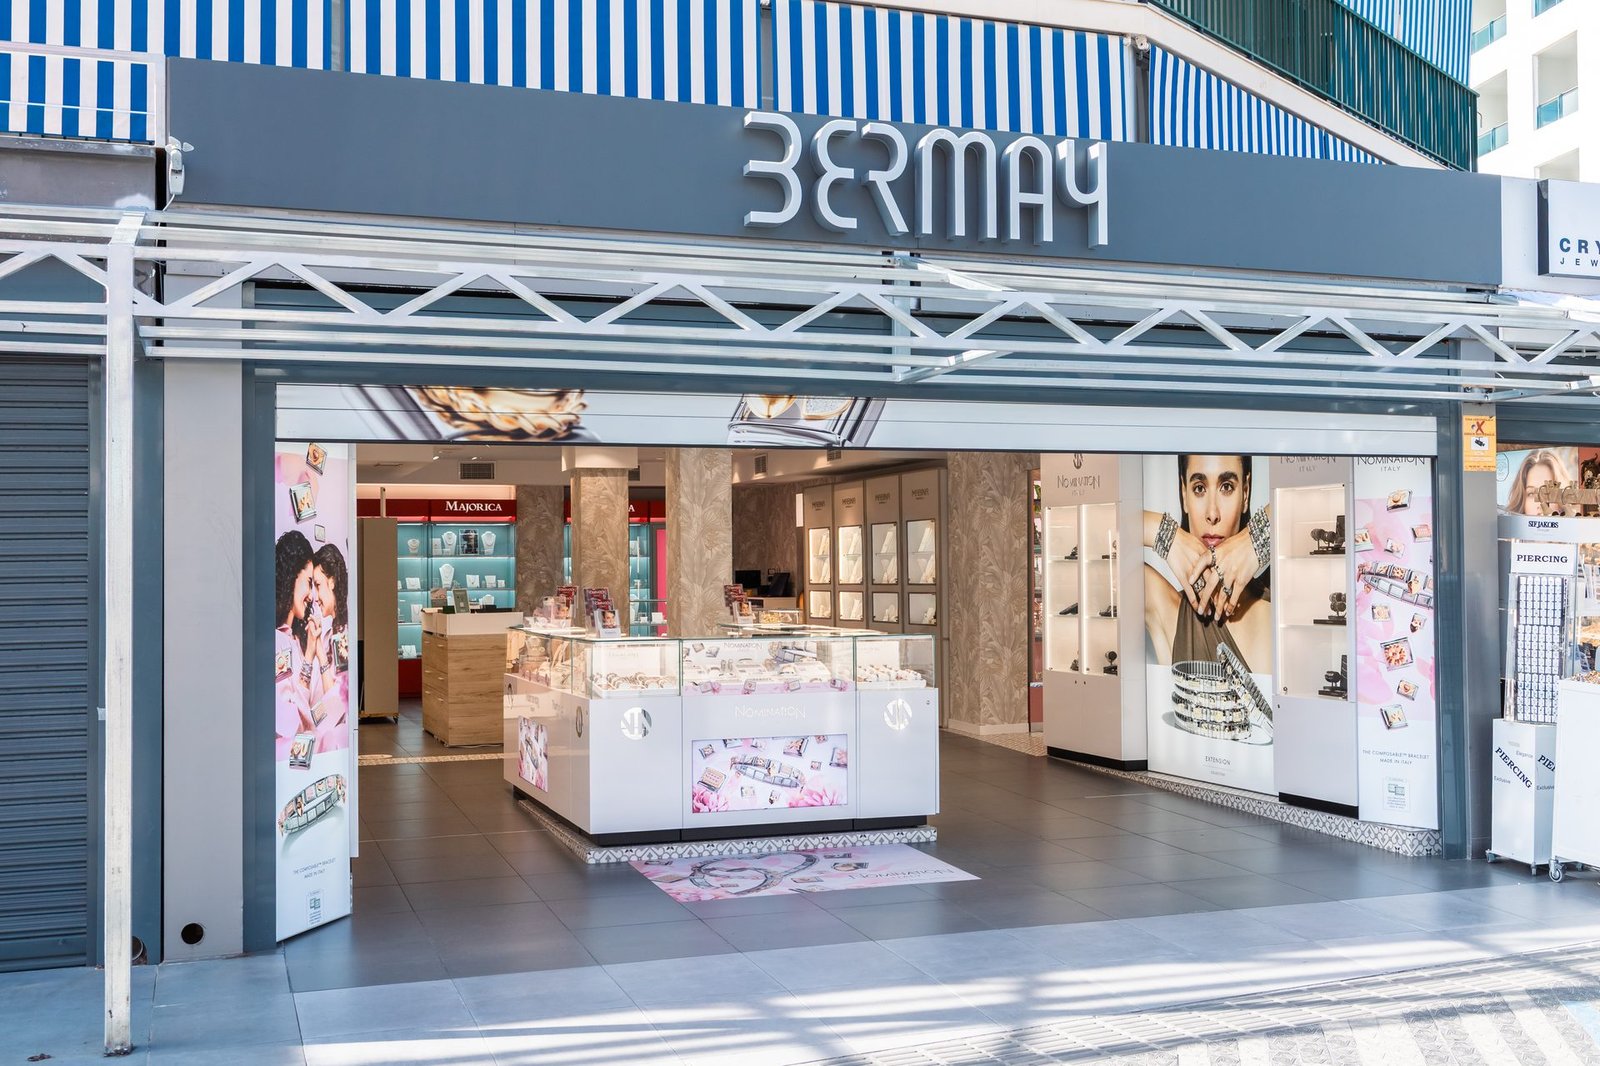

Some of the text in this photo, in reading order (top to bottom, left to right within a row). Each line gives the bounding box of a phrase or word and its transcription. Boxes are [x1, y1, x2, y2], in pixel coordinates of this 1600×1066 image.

[743, 111, 1108, 249] BERMAY
[1516, 554, 1569, 564] PIERCING
[1495, 747, 1533, 789] PIERCING
